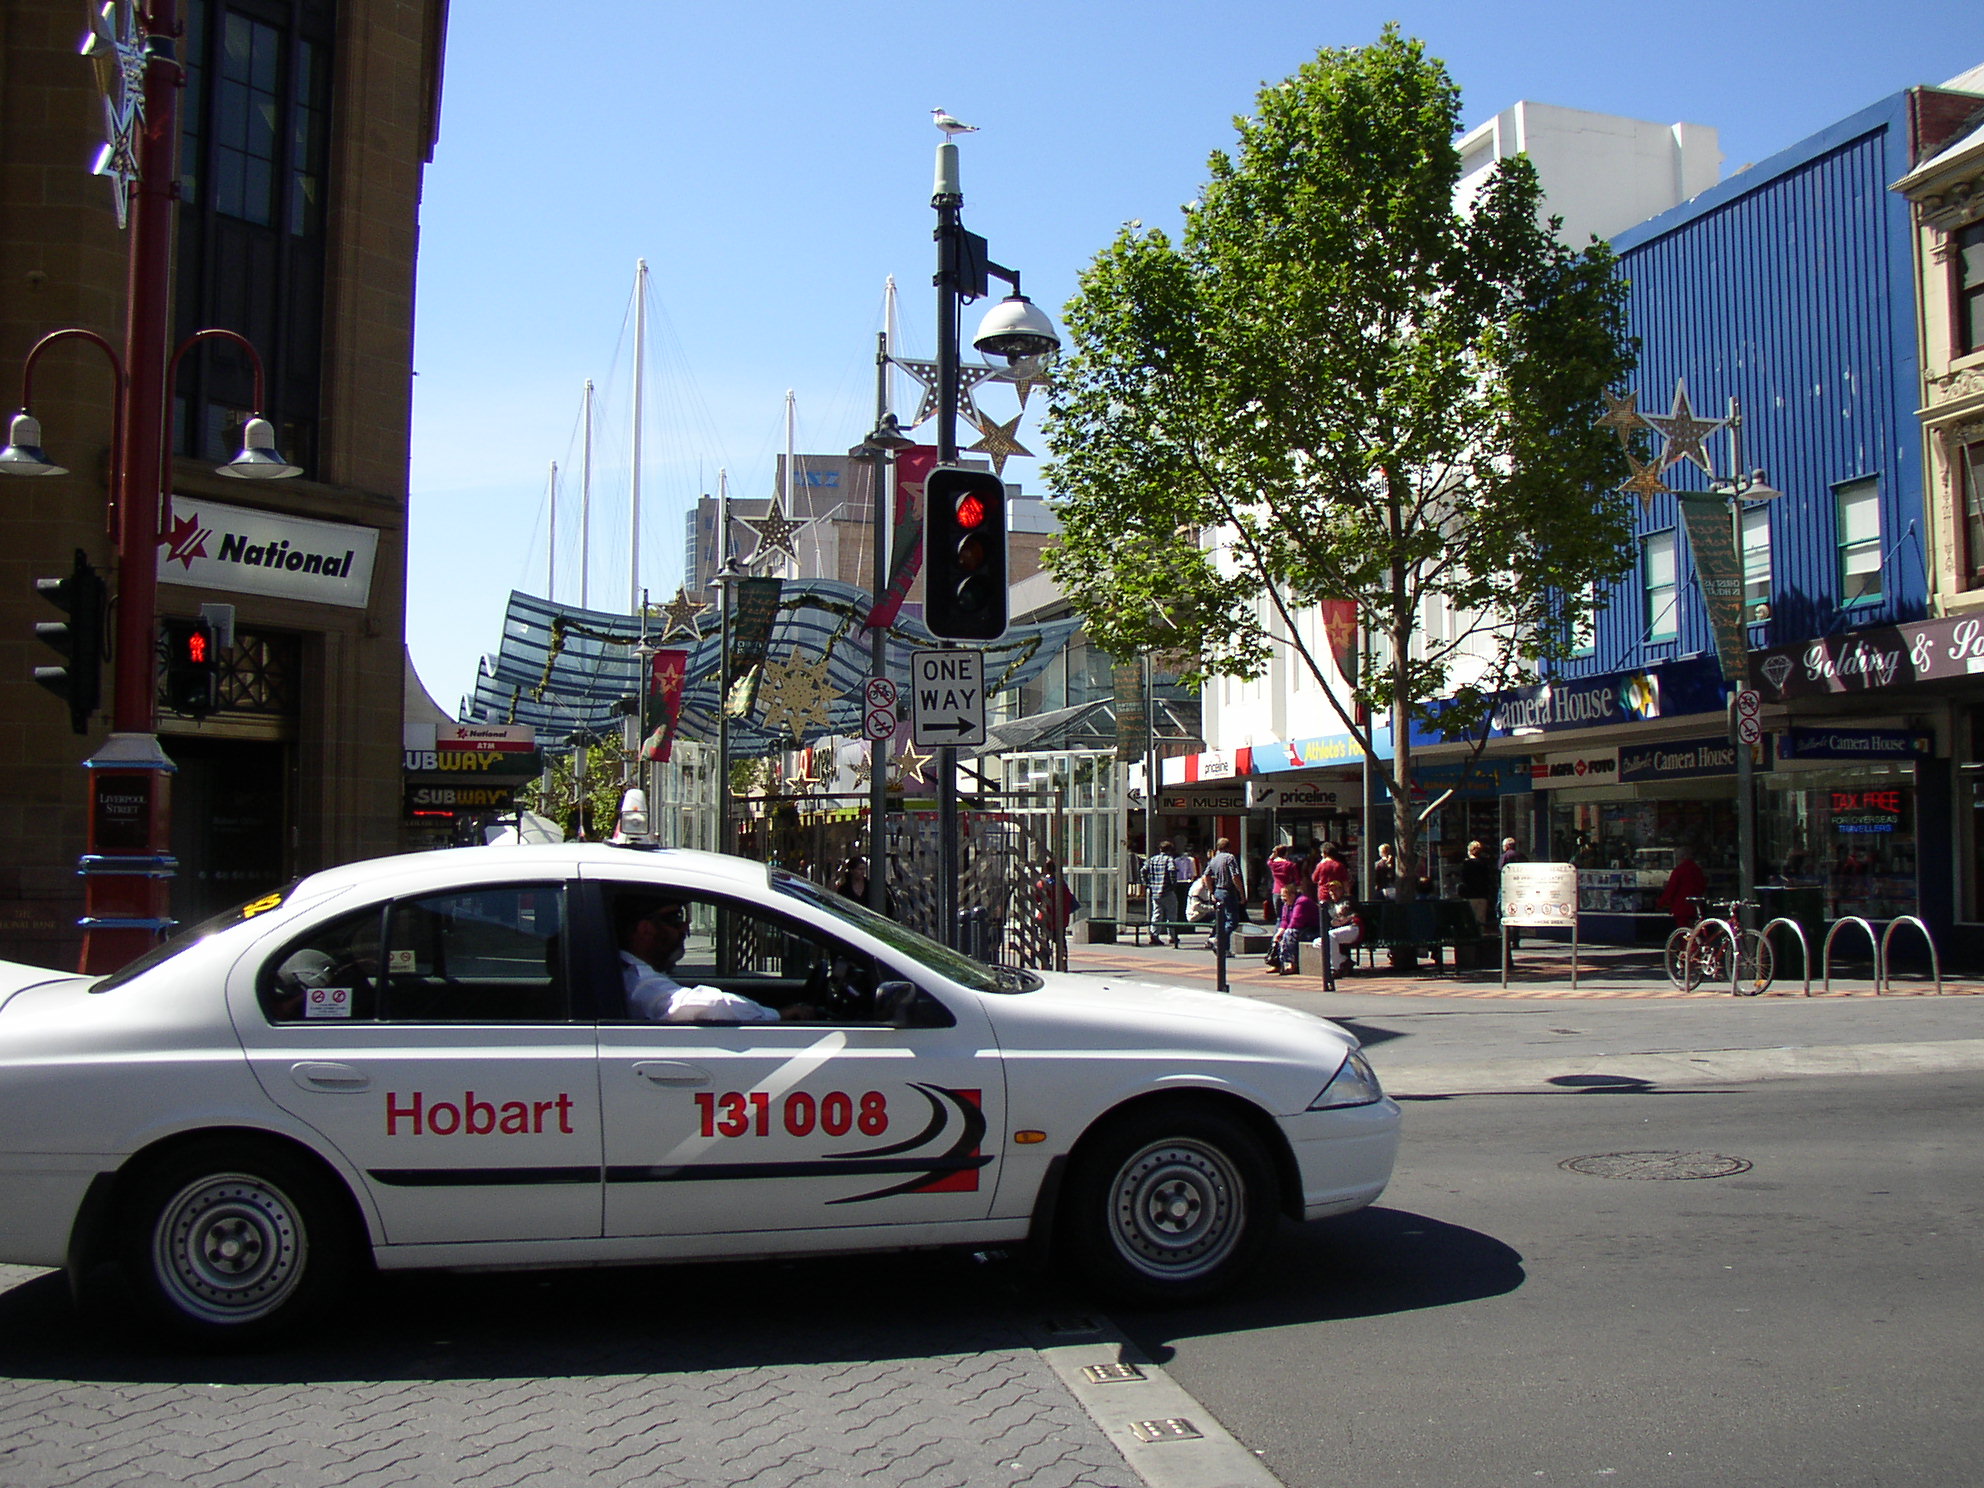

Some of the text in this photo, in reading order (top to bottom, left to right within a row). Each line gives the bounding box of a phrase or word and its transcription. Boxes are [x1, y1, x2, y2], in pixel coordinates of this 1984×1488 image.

[217, 533, 354, 578] National
[923, 659, 972, 681] ONE
[1803, 640, 1900, 685] Golding
[1910, 632, 1933, 673] &
[920, 688, 977, 711] WAY
[1553, 686, 1613, 723] House
[469, 729, 507, 738] National
[1829, 735, 1870, 751] Camera
[1871, 735, 1906, 751] House
[404, 751, 504, 771] UBWAY
[1653, 751, 1696, 771] Camera
[1698, 746, 1735, 767] House
[413, 788, 509, 805] SUBWAY
[1163, 797, 1246, 809] IN2 MUSIC
[1280, 787, 1337, 806] priceline
[1831, 790, 1902, 813] TAX FREE
[386, 1091, 574, 1136] Hobart
[694, 1091, 889, 1137] 131 008
